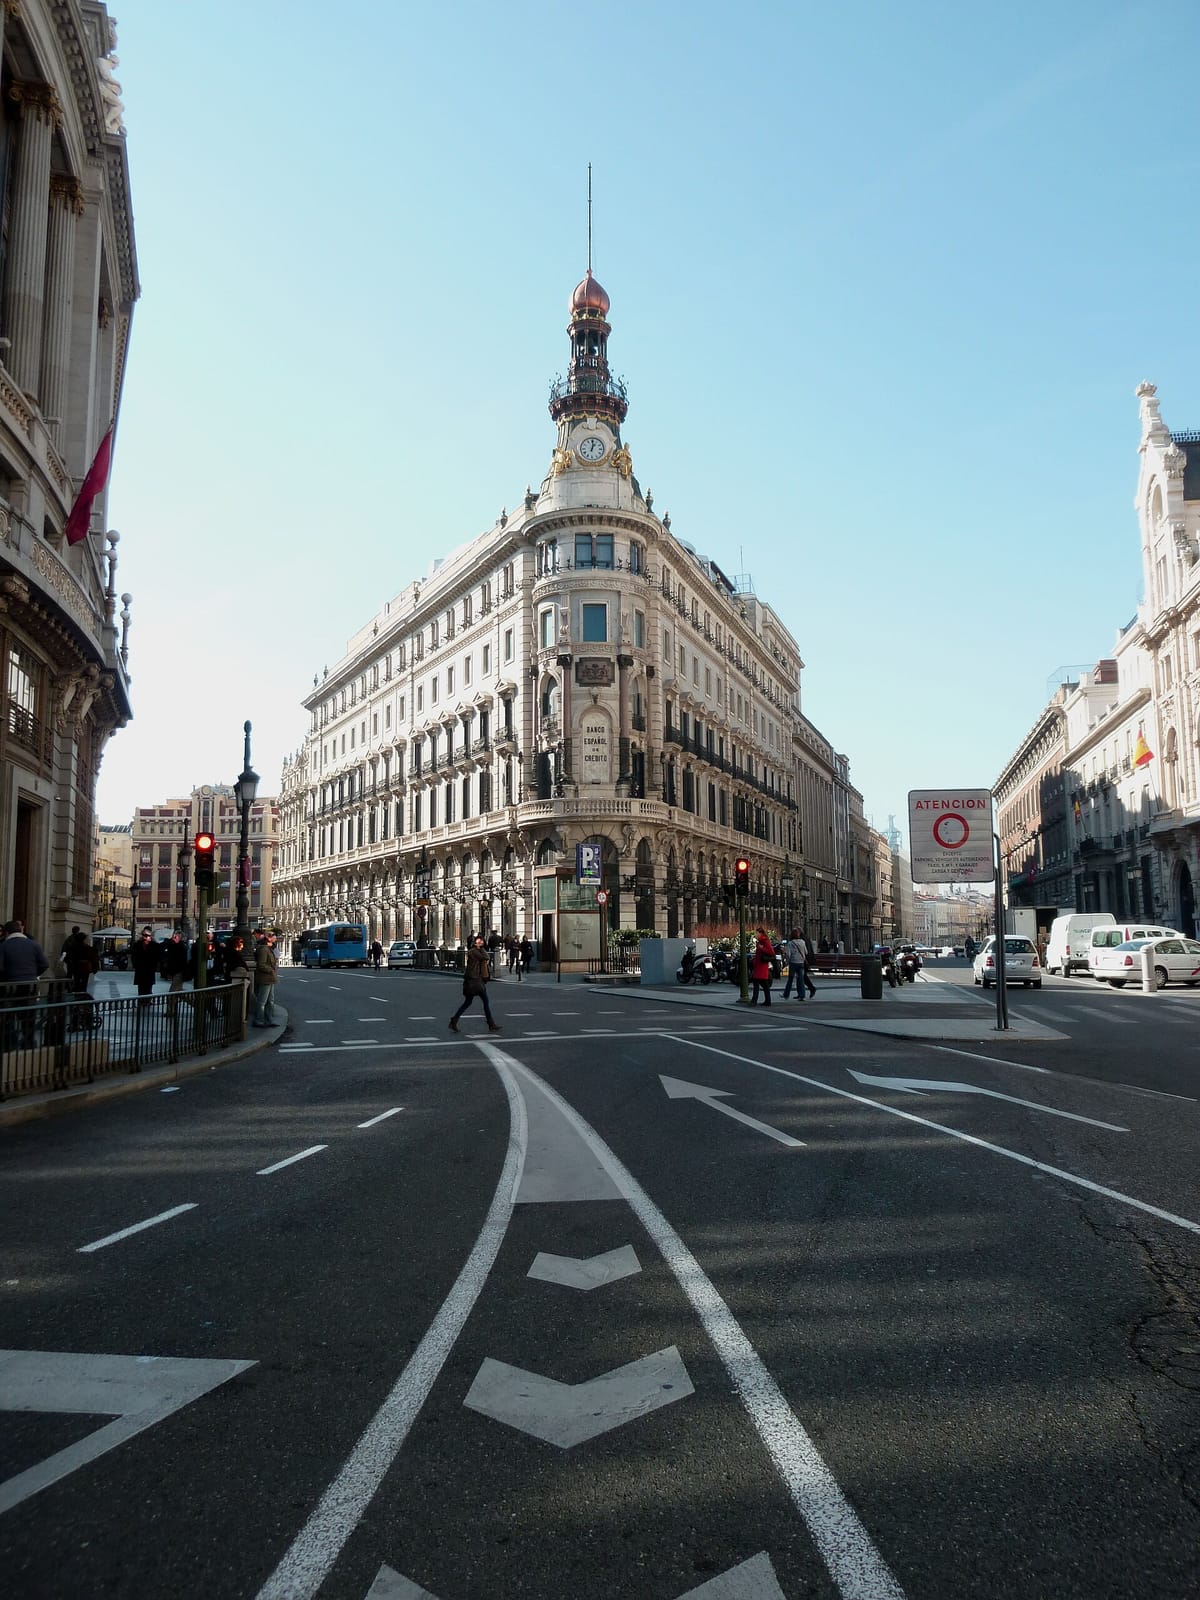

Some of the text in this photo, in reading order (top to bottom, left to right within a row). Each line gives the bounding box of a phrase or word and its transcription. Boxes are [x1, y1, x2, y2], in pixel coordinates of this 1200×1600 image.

[584, 736, 607, 745] ESPAÑOL
[915, 799, 986, 809] ATENCION
[582, 847, 593, 868] P
